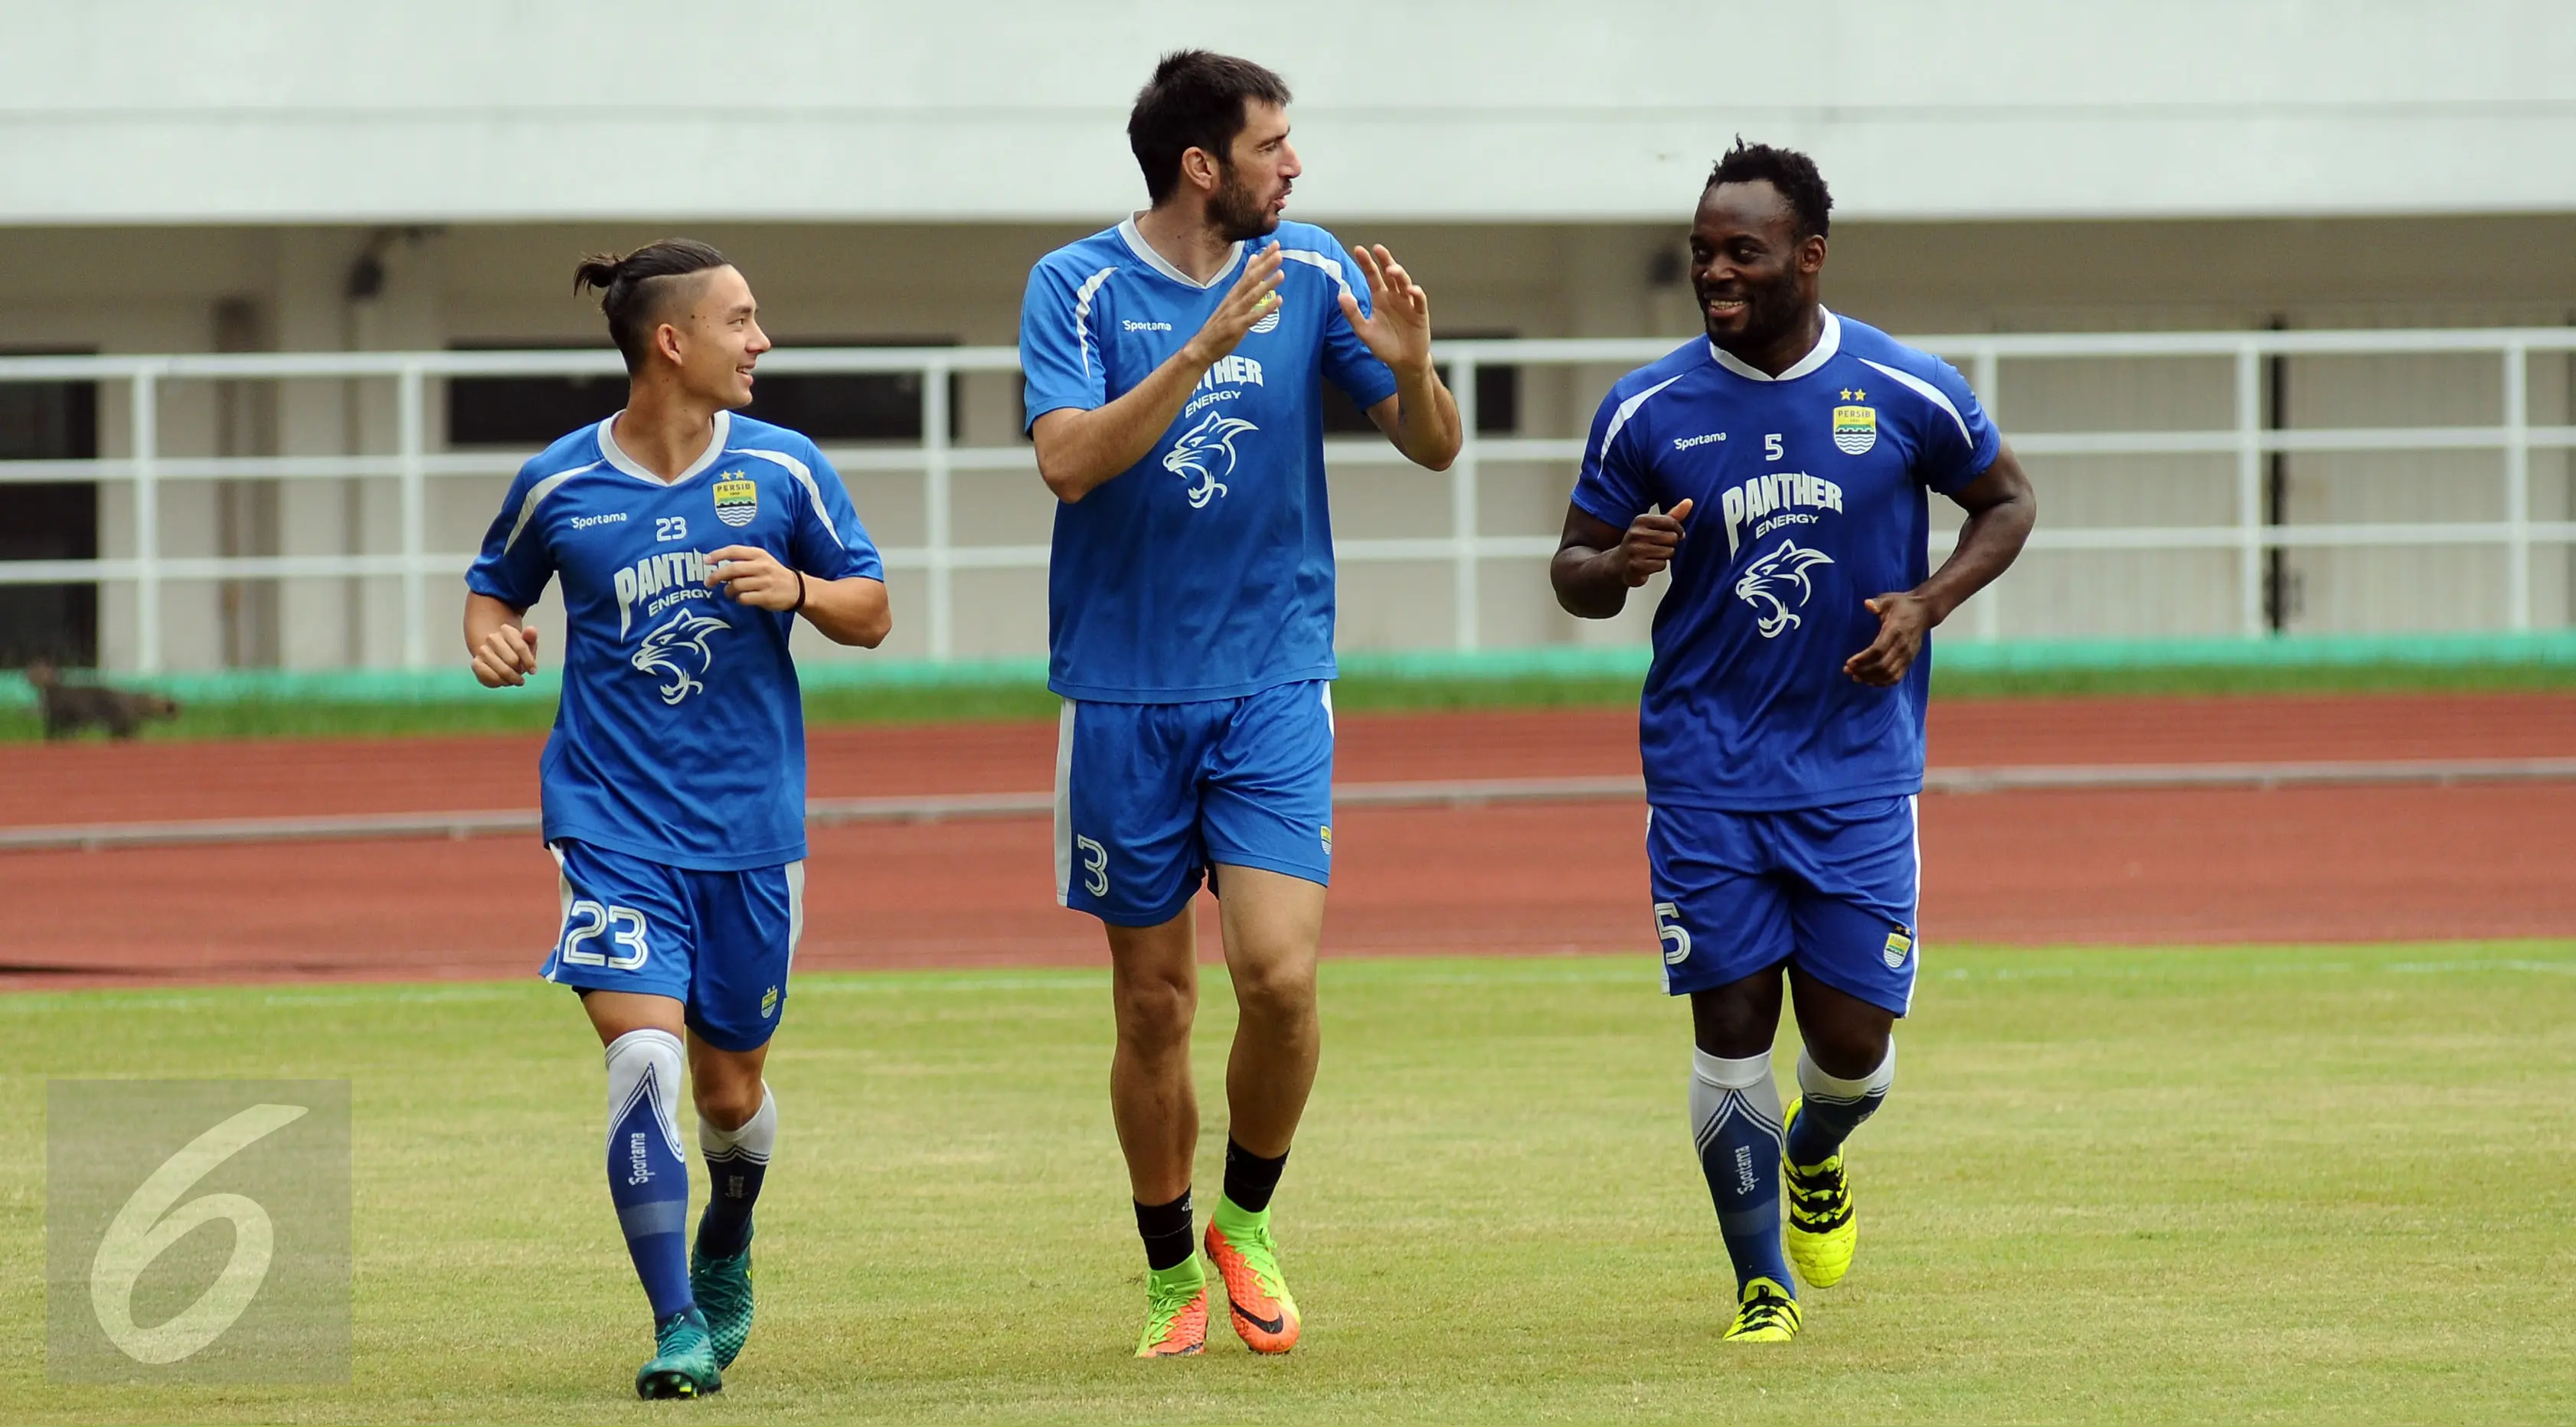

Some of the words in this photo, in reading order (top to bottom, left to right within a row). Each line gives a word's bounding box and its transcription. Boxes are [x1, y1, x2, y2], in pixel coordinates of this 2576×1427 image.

[1122, 320, 1172, 332] Sportama
[1185, 390, 1241, 419] ENERGY
[1673, 432, 1727, 451] Sportama
[1764, 433, 1784, 461] 5
[717, 483, 750, 491] PERSIB
[570, 512, 627, 530] Sportama
[655, 516, 687, 542] 23
[1722, 470, 1842, 565] PANTHER
[1756, 514, 1819, 540] ENERGY
[648, 589, 713, 617] ENERGY
[1077, 834, 1109, 897] 3
[563, 900, 649, 971] 23
[1654, 902, 1691, 965] 5
[628, 1133, 655, 1185] Sportama
[1734, 1145, 1760, 1195] Sportama
